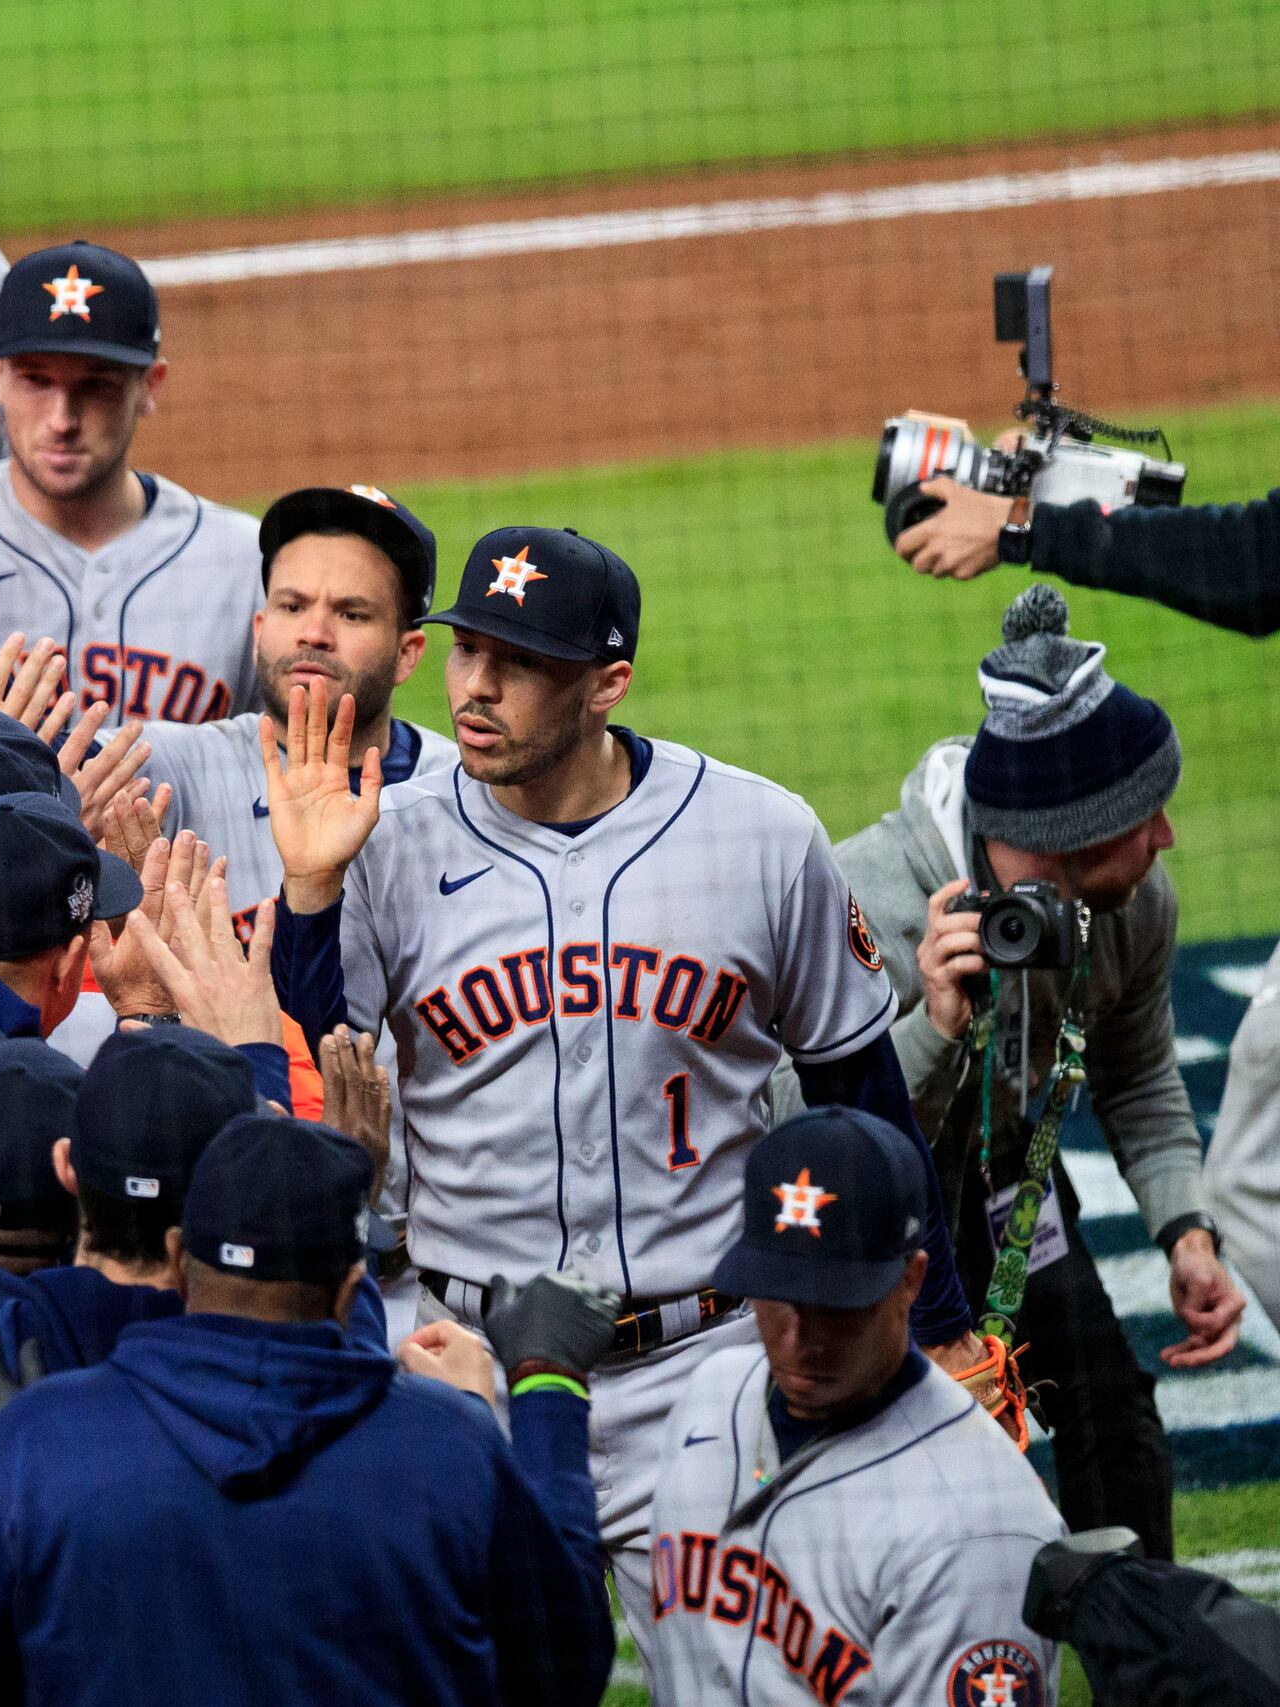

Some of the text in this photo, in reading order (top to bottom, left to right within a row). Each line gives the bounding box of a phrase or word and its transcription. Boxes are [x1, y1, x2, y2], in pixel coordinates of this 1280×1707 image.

[415, 942, 748, 1065] HOUSTON
[663, 1072, 700, 1171] 1
[653, 1530, 873, 1707] OUSTON
[961, 1645, 1033, 1673] HOUSTON
